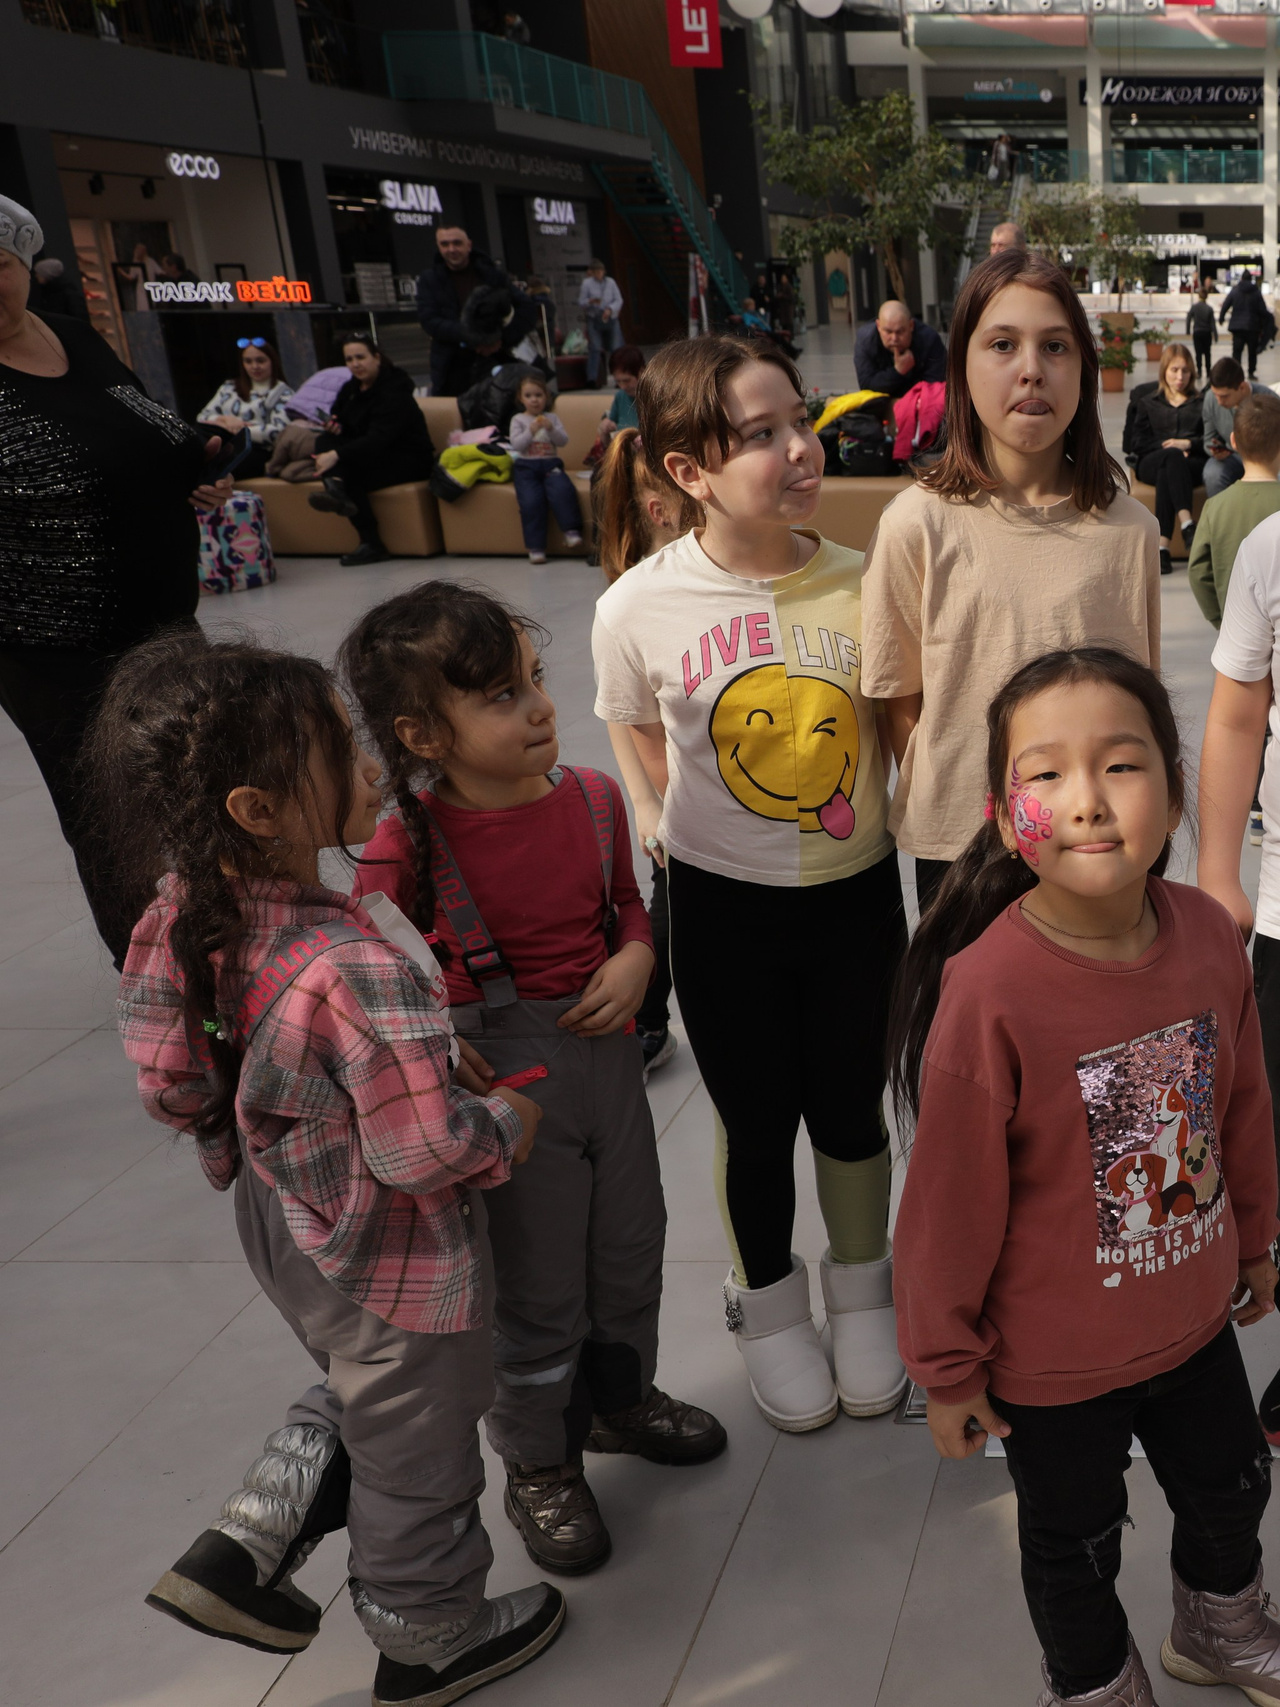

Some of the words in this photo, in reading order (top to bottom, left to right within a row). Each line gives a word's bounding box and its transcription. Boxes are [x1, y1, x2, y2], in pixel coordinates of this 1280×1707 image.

[681, 0, 709, 53] LE
[350, 126, 434, 158] УНИВЕРМАГ
[168, 152, 220, 180] ecco
[381, 180, 443, 213] SLAVA
[533, 197, 576, 224] SLAVA
[395, 212, 433, 226] CONCEPT
[144, 281, 234, 302] ТАБАК
[236, 276, 312, 302] ВЕЙП
[682, 612, 774, 700] LIVE
[792, 625, 862, 676] LIF
[1096, 1241, 1155, 1264] HOME
[1165, 1229, 1183, 1252] IS
[1192, 1195, 1226, 1238] WHERE
[1132, 1257, 1166, 1277] THE
[1172, 1244, 1201, 1266] DOG
[1205, 1229, 1214, 1247] IS
